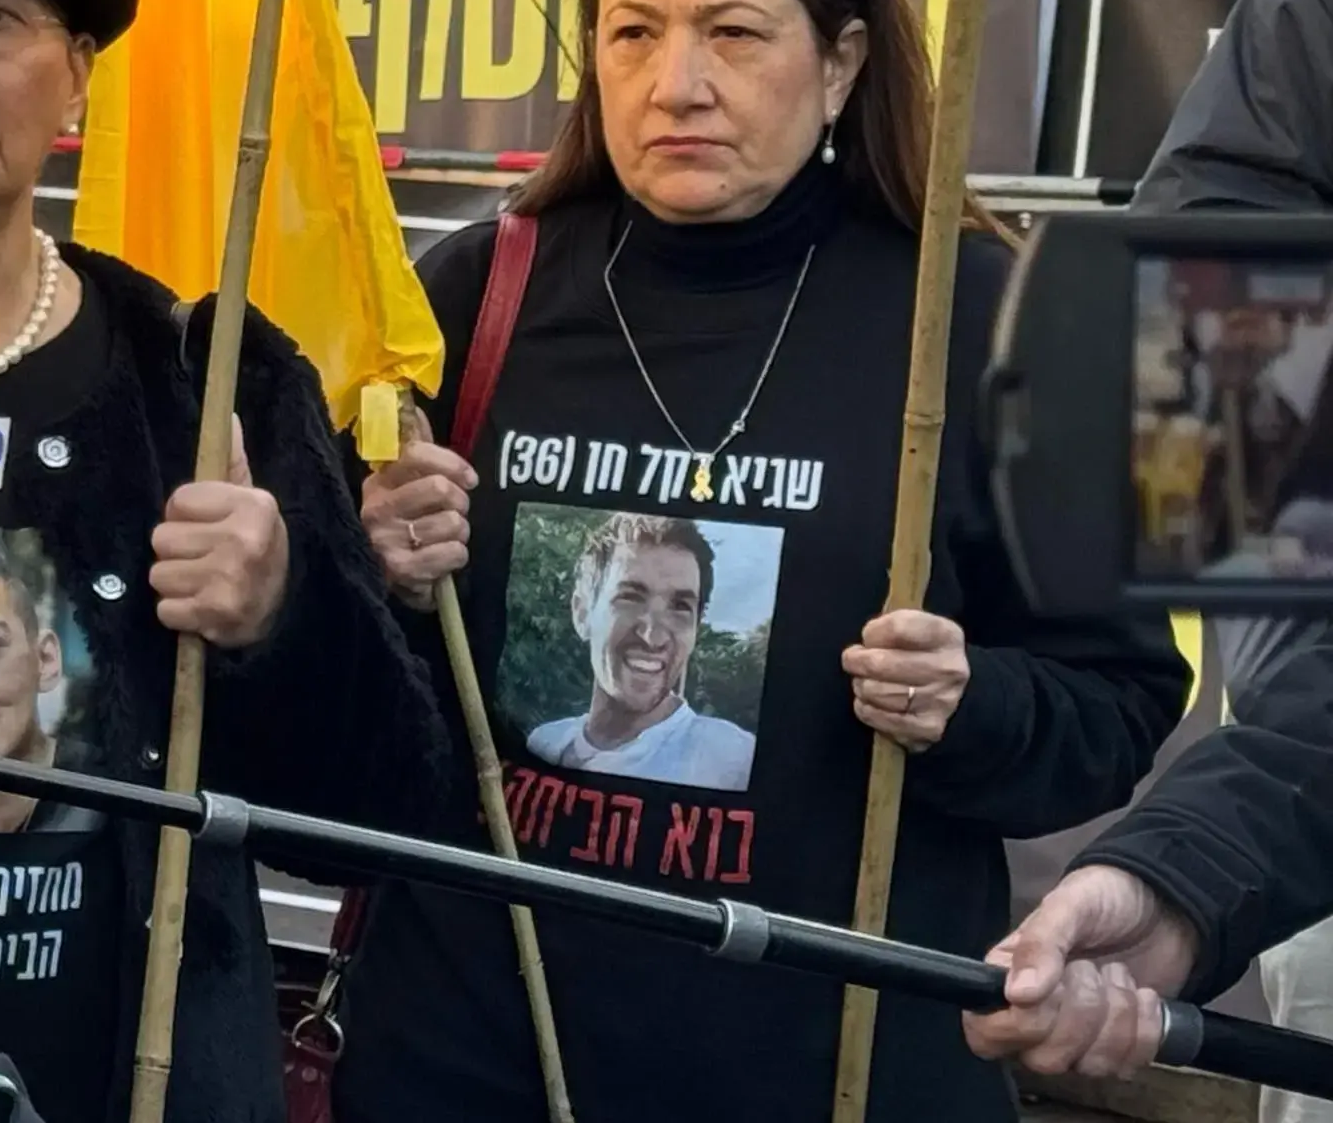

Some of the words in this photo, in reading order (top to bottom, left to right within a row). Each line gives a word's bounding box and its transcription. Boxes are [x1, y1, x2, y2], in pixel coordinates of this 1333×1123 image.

[499, 430, 576, 492] (36)
[582, 441, 628, 495] חן
[659, 802, 754, 884] בוא
